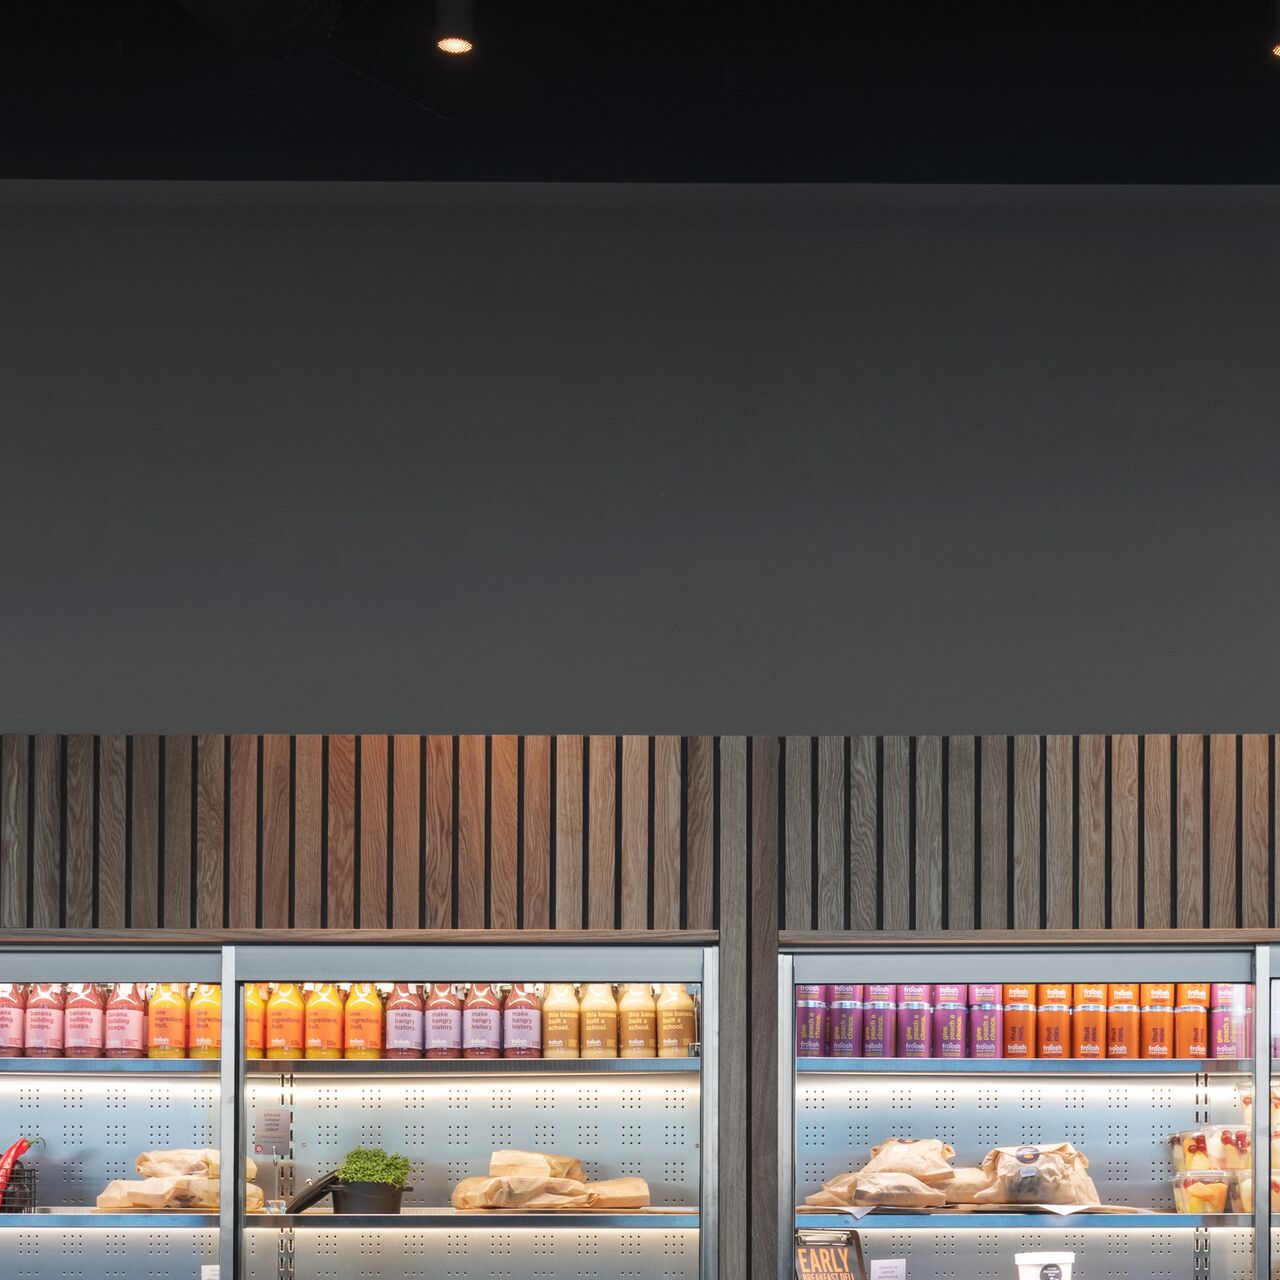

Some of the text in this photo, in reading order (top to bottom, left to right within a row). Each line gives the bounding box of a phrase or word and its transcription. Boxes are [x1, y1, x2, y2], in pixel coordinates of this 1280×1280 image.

[394, 1018, 415, 1026] hangry
[431, 1018, 452, 1026] hangry
[797, 1247, 849, 1273] EARLY
